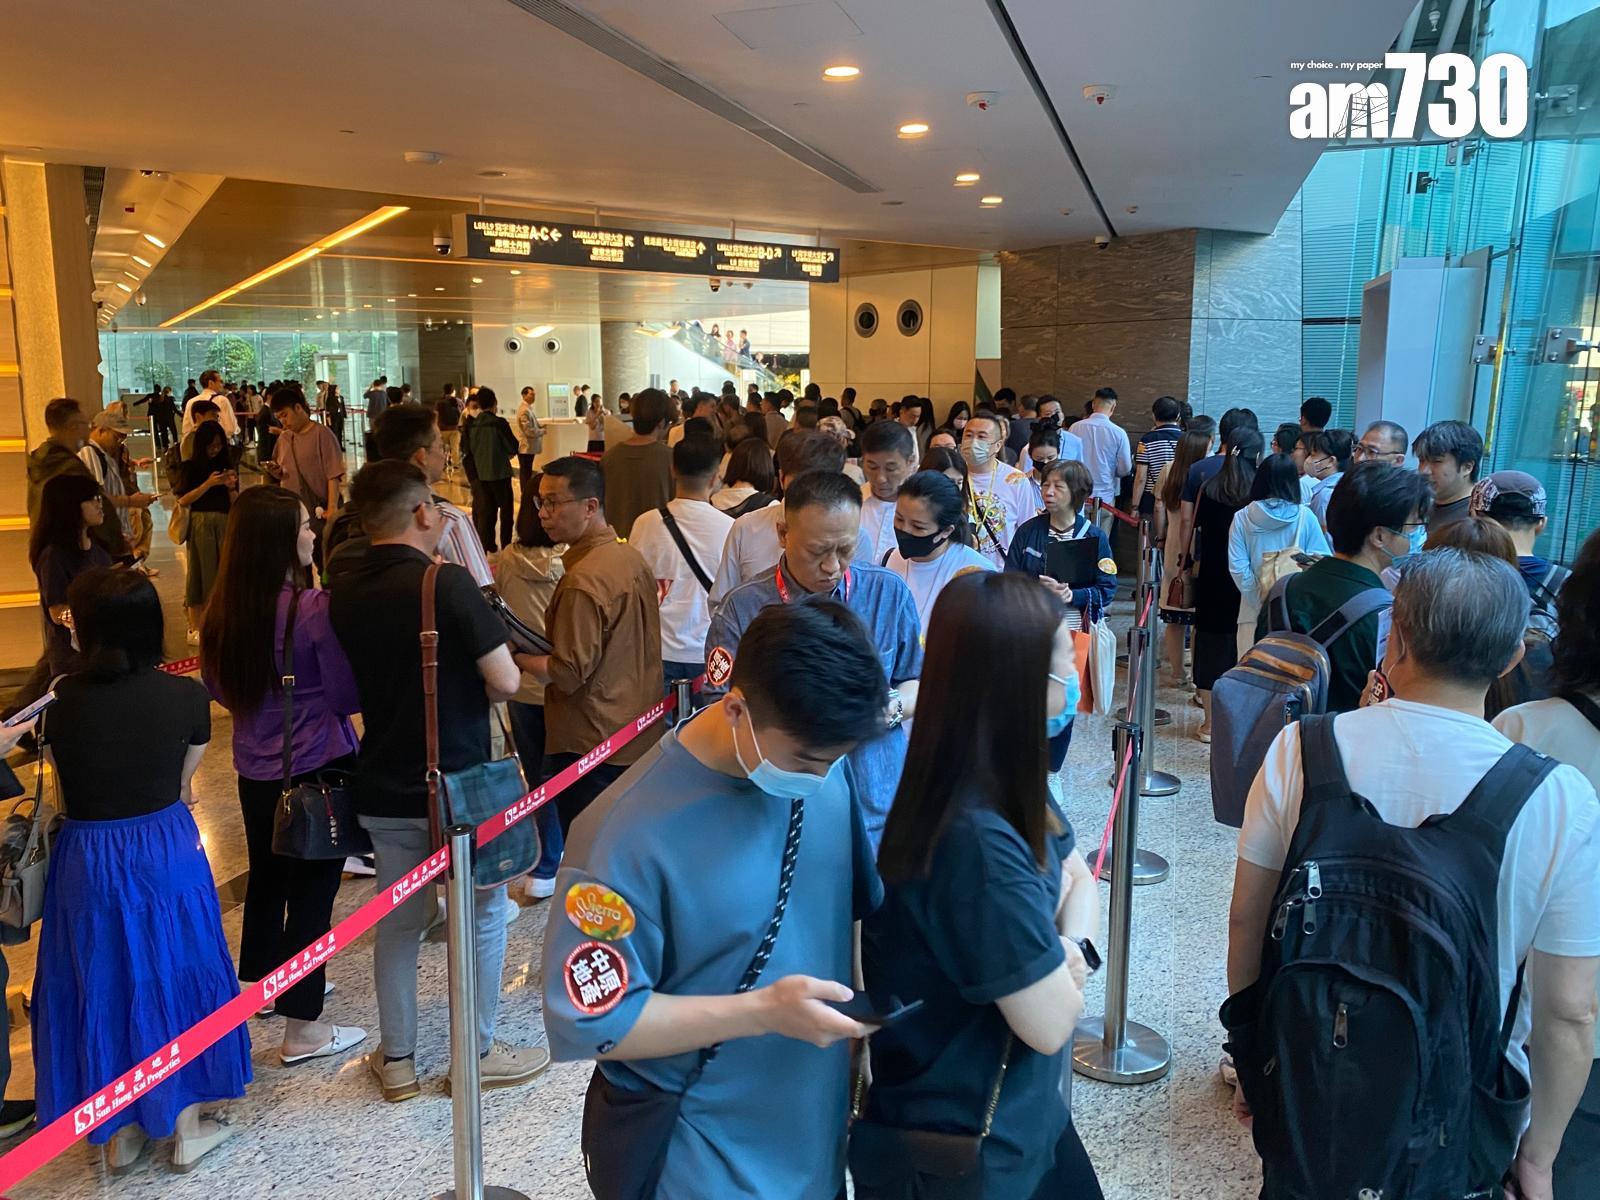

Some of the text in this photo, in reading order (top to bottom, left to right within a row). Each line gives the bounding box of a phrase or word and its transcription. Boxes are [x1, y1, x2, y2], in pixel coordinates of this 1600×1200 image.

[571, 958, 602, 1007] 地產
[591, 949, 621, 996] 中原
[95, 1057, 181, 1121] Sun Hung Kai Properties
